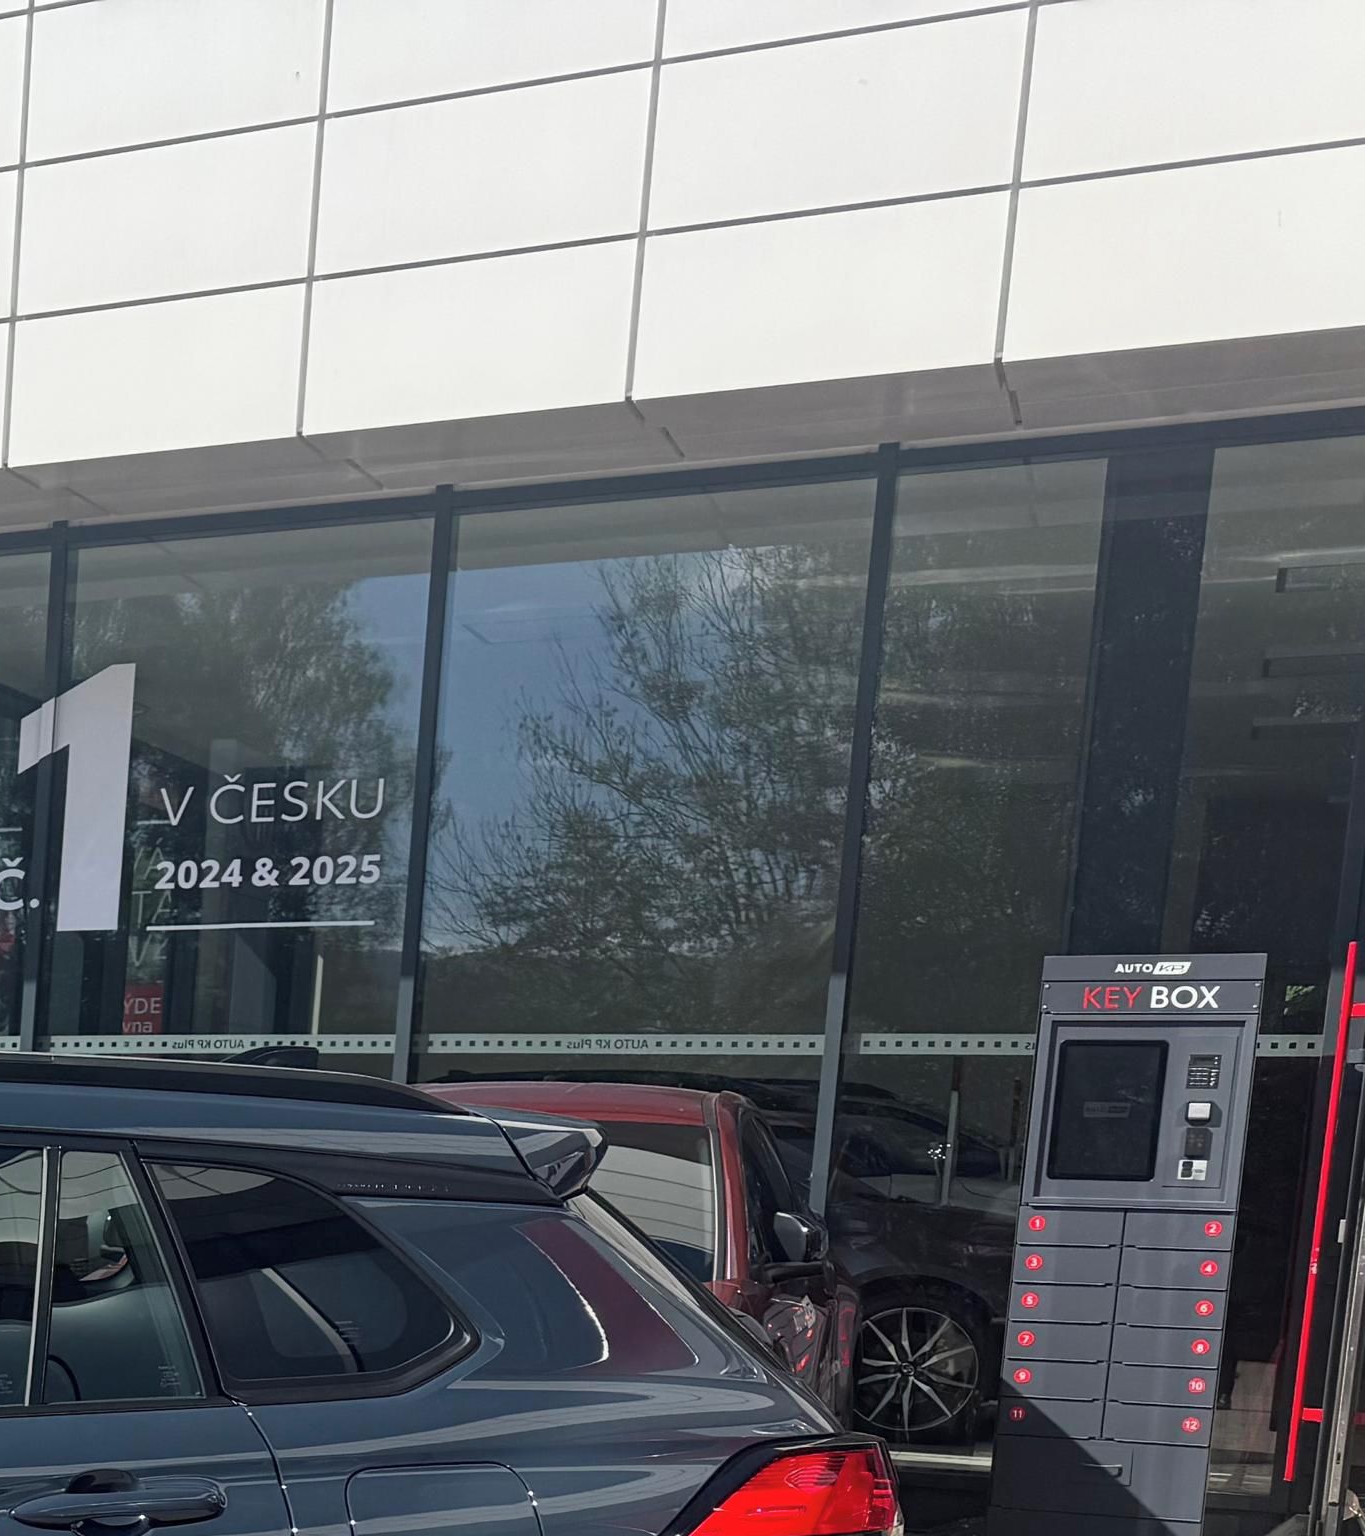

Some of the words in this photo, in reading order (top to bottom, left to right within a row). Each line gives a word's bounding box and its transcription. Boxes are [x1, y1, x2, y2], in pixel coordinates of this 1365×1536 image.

[17, 662, 137, 932] 1
[159, 786, 195, 826] V
[209, 773, 385, 825] ČESKU
[154, 858, 244, 890] 2024
[251, 857, 280, 887] &
[288, 854, 382, 886] 2025
[1114, 963, 1153, 974] AUTO
[1082, 986, 1143, 1009] KEY
[1149, 985, 1221, 1009] BOX
[1190, 1381, 1203, 1391] 10
[1012, 1410, 1023, 1419] 11
[1185, 1420, 1198, 1430] 12
